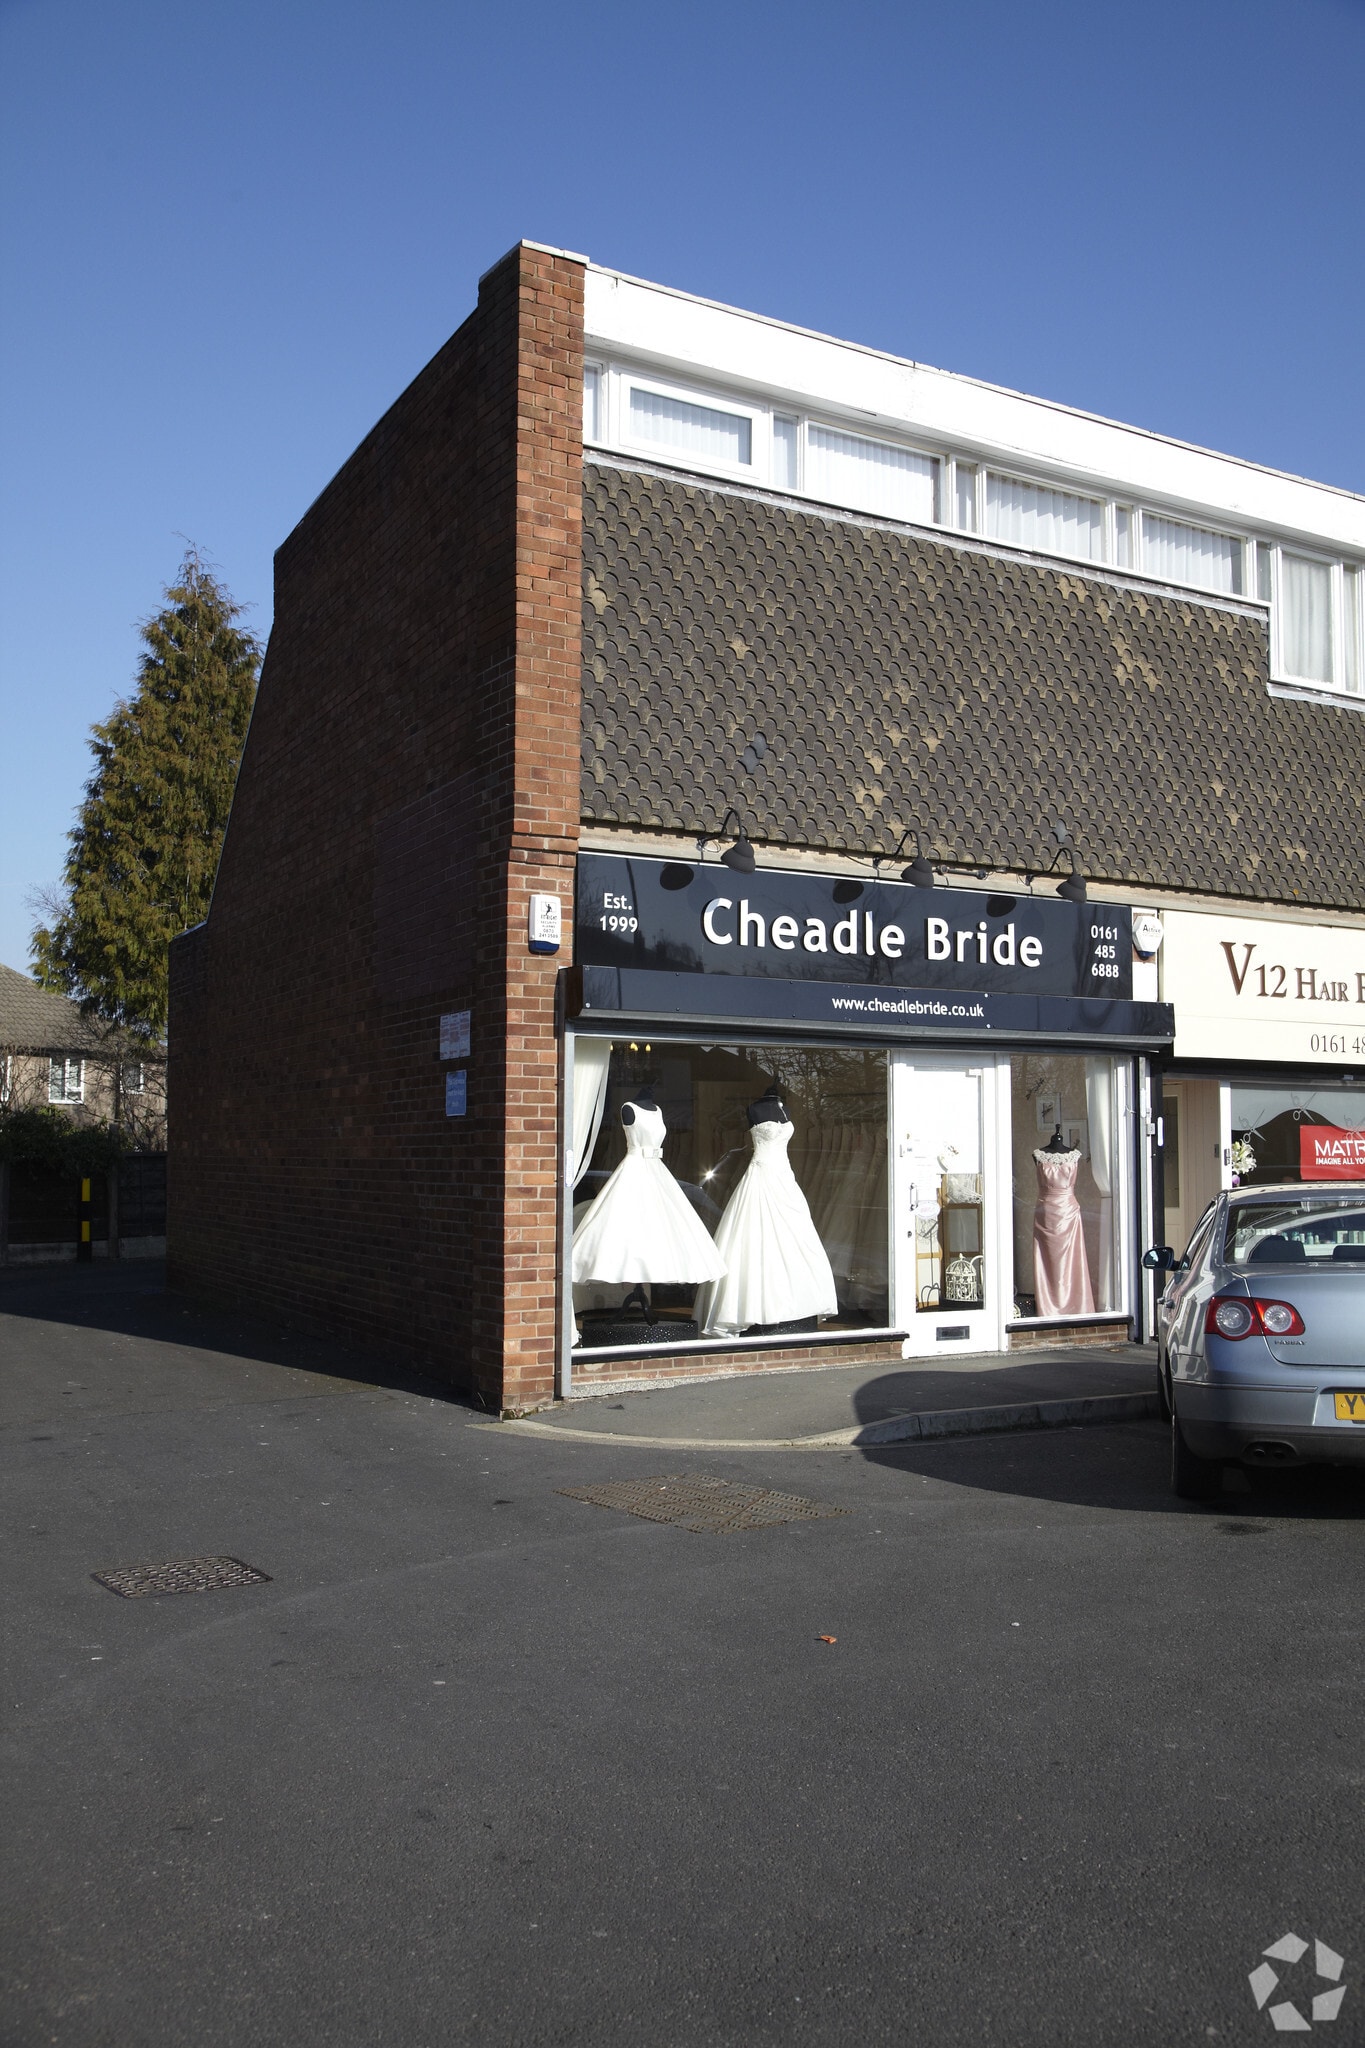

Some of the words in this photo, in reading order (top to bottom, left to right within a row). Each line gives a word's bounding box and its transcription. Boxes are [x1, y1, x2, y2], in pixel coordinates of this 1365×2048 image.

[603, 892, 633, 911] Est.
[599, 915, 639, 933] 1999
[702, 897, 906, 959] Cheadle
[926, 917, 1043, 968] Bride
[1090, 925, 1118, 940] 0161
[1094, 944, 1116, 959] 485
[1091, 963, 1120, 978] 6888
[1220, 941, 1288, 998] V12
[1294, 967, 1349, 1002] HAIR
[831, 998, 985, 1017] www.cheadlebride.co.uk
[1310, 1033, 1346, 1053] 0161
[1316, 1157, 1342, 1165] IMAGINE
[1342, 1157, 1354, 1165] ALL
